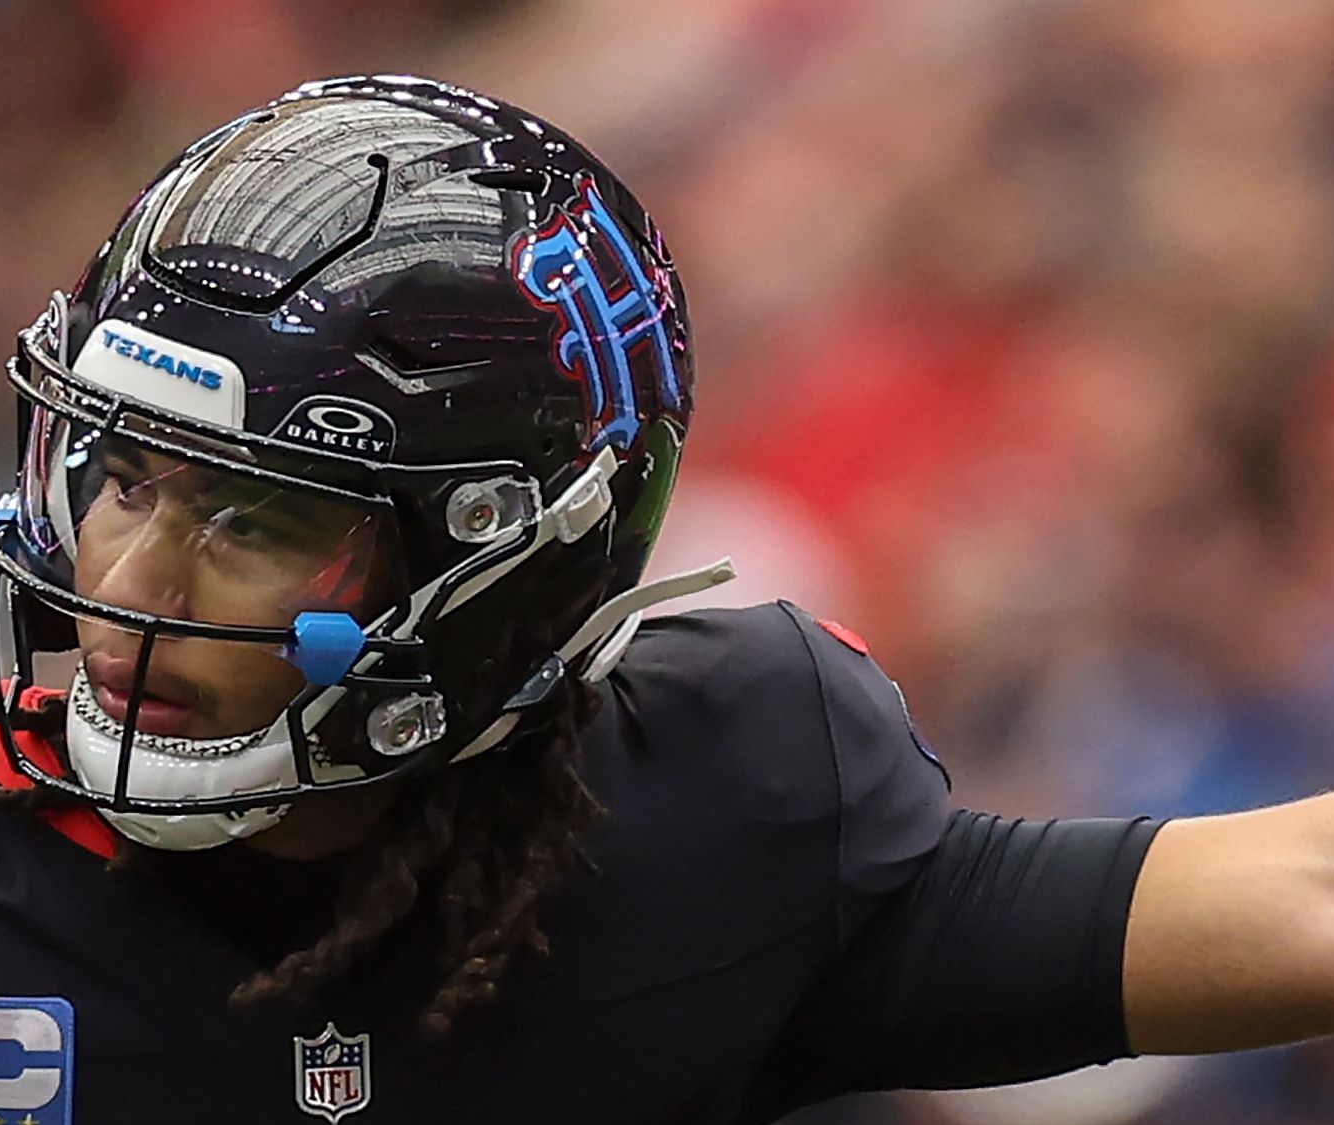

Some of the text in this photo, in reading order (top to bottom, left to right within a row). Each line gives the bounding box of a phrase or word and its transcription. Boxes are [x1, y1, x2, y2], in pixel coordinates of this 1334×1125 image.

[102, 328, 224, 391] TEXANS
[286, 422, 387, 453] OAKLEY
[308, 1070, 359, 1106] NFL
